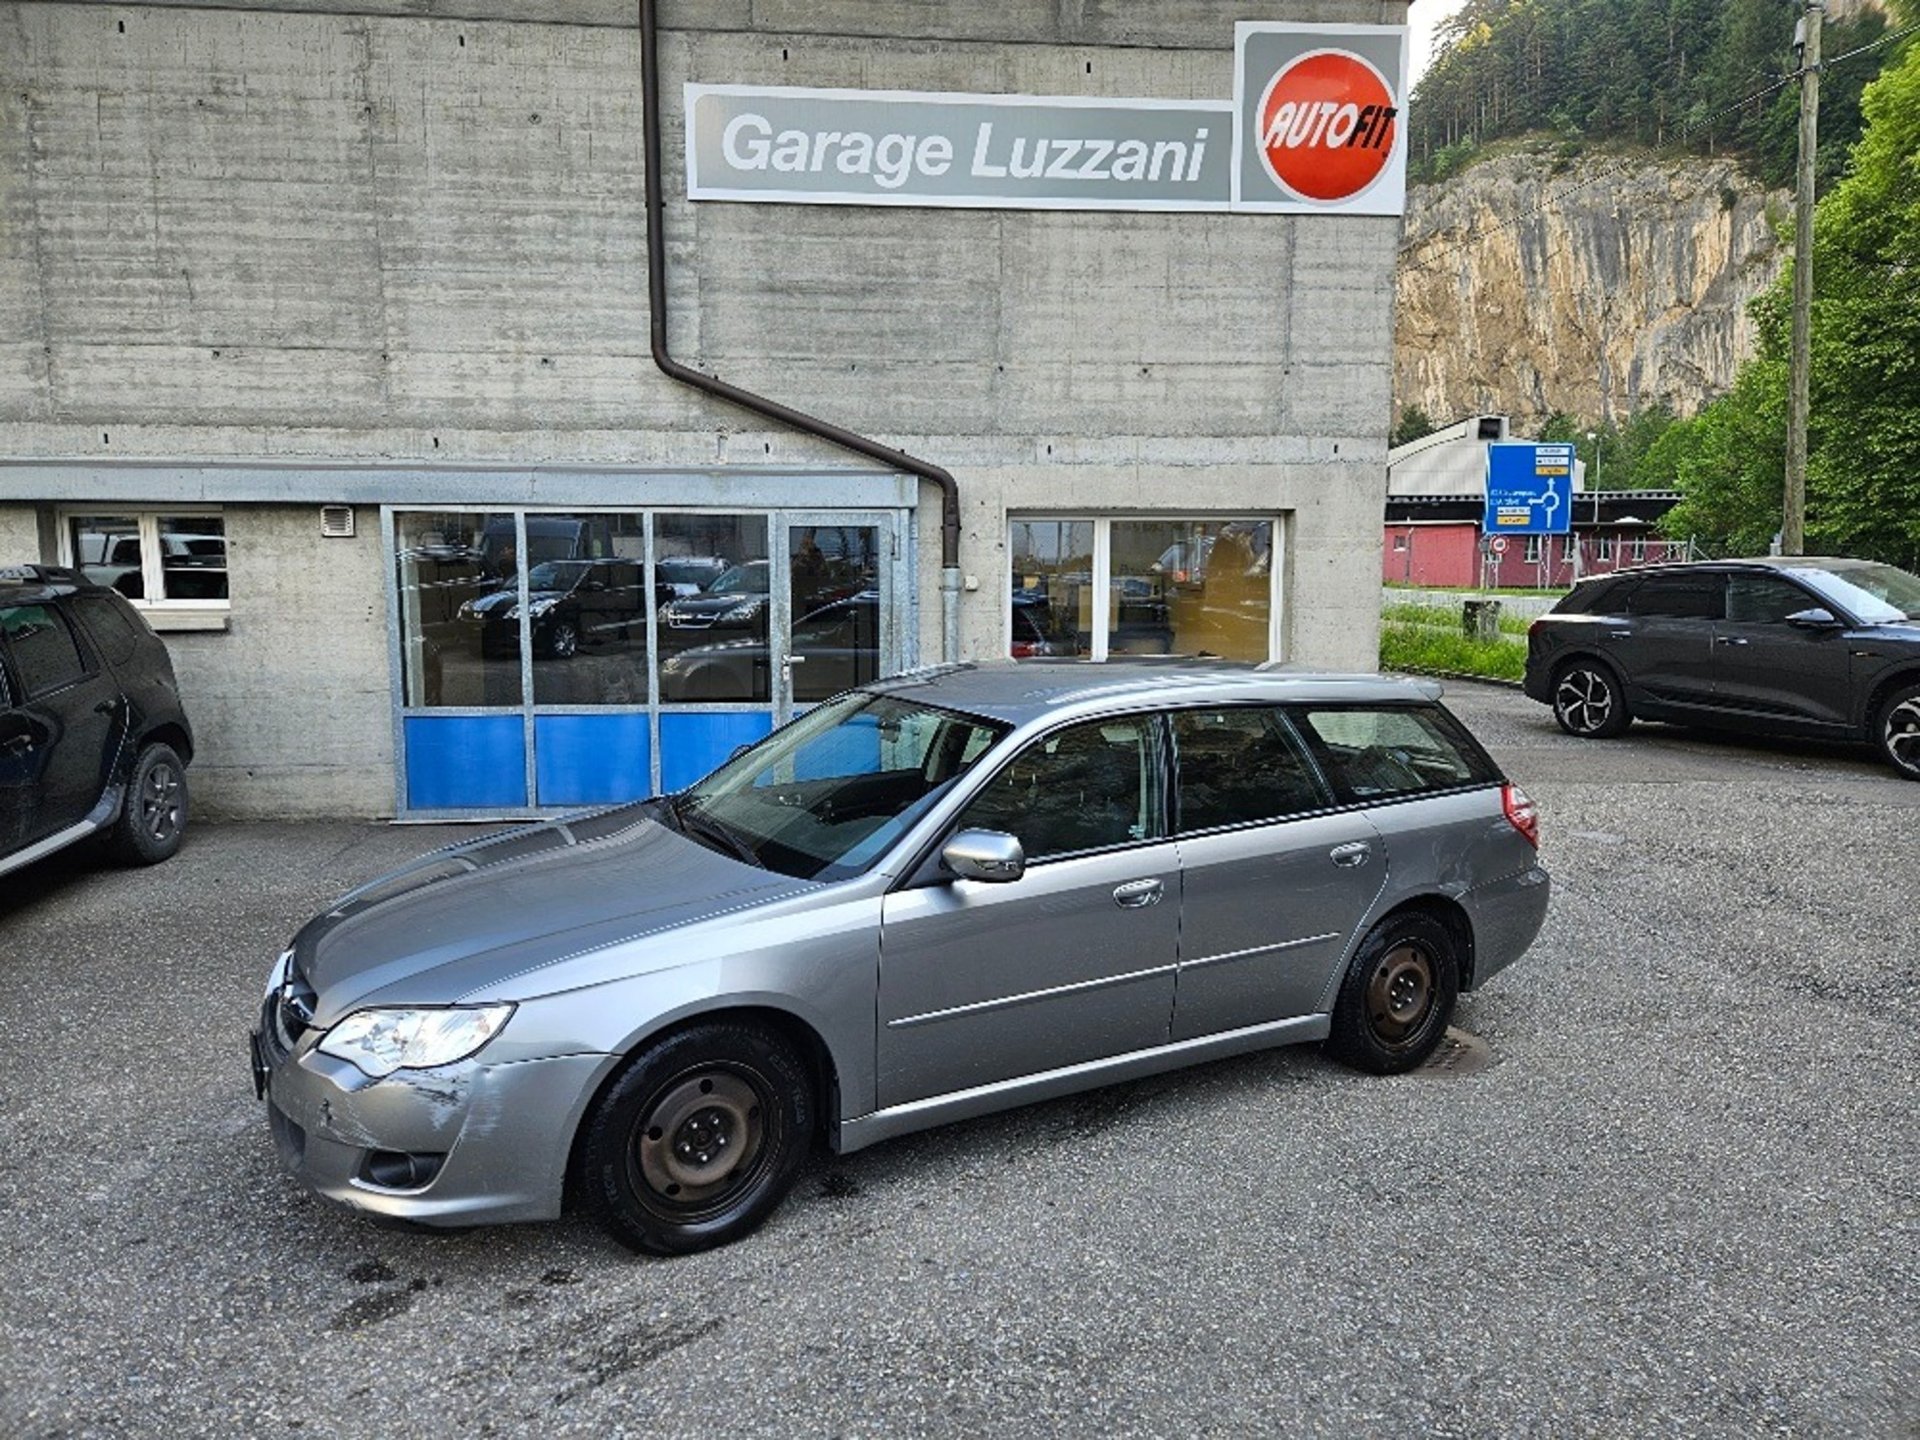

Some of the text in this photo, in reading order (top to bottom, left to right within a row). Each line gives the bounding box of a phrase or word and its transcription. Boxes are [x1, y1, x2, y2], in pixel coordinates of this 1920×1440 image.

[722, 113, 1208, 188] Garage Luzzani
[1264, 101, 1398, 149] AUTOFIT
